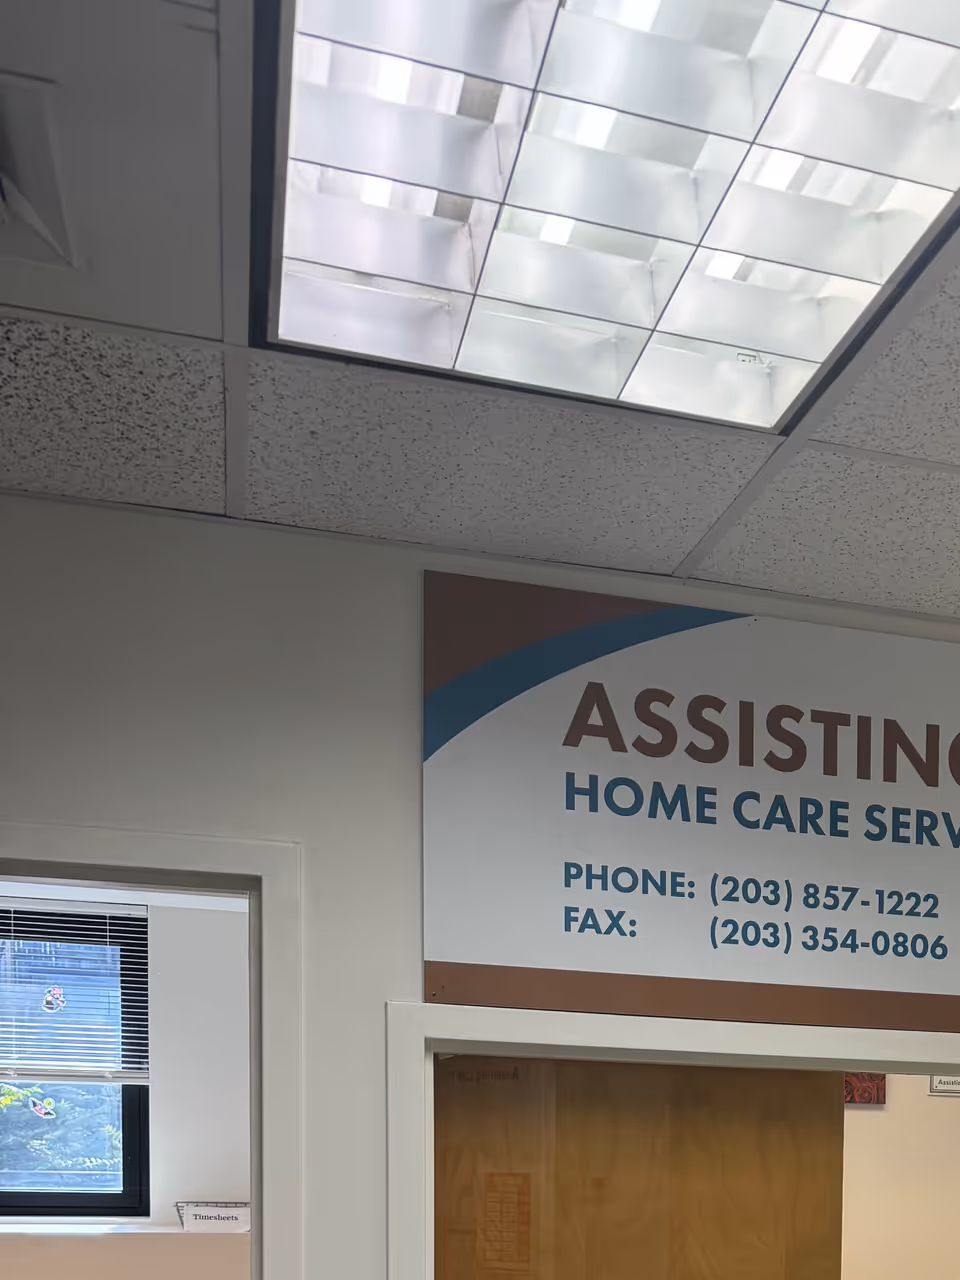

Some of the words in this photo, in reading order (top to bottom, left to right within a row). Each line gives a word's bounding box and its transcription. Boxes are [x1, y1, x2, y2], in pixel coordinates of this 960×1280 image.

[565, 772, 717, 825] HOME
[732, 790, 850, 838] CARE
[563, 861, 696, 900] PHONE:
[710, 873, 793, 913] (203)
[802, 883, 940, 918] 857-1222
[563, 905, 637, 938] FAX:
[710, 916, 792, 954] (203)
[801, 925, 949, 960] 354-0806
[192, 1213, 239, 1221] Timesheets
